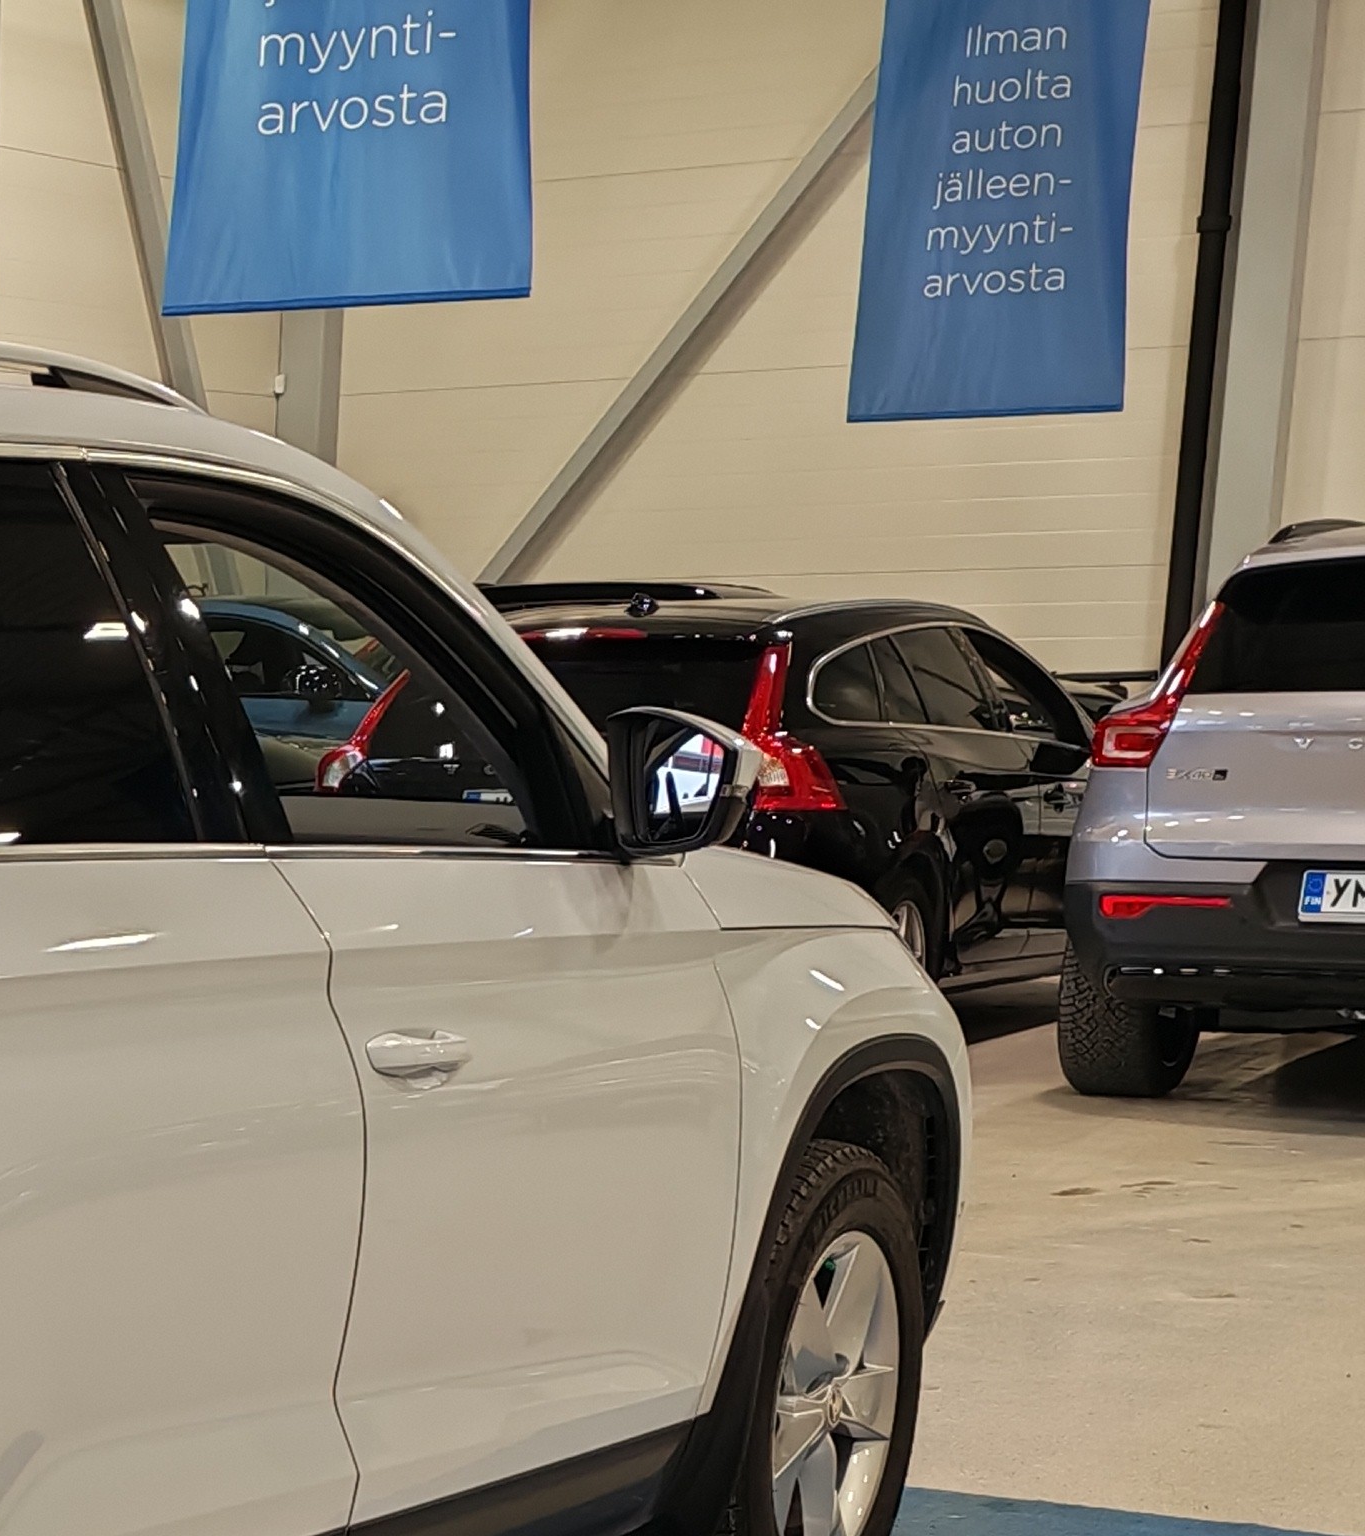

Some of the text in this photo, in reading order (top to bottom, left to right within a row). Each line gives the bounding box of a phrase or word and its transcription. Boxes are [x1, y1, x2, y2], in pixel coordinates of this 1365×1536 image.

[259, 10, 457, 74] myynti-
[966, 25, 1067, 58] Ilman
[953, 68, 1072, 107] huolta
[258, 84, 448, 135] arvosta
[951, 121, 1062, 154] auton
[932, 171, 1073, 210] jälleen-
[926, 213, 1074, 255] myynti-
[923, 262, 1066, 299] arvosta
